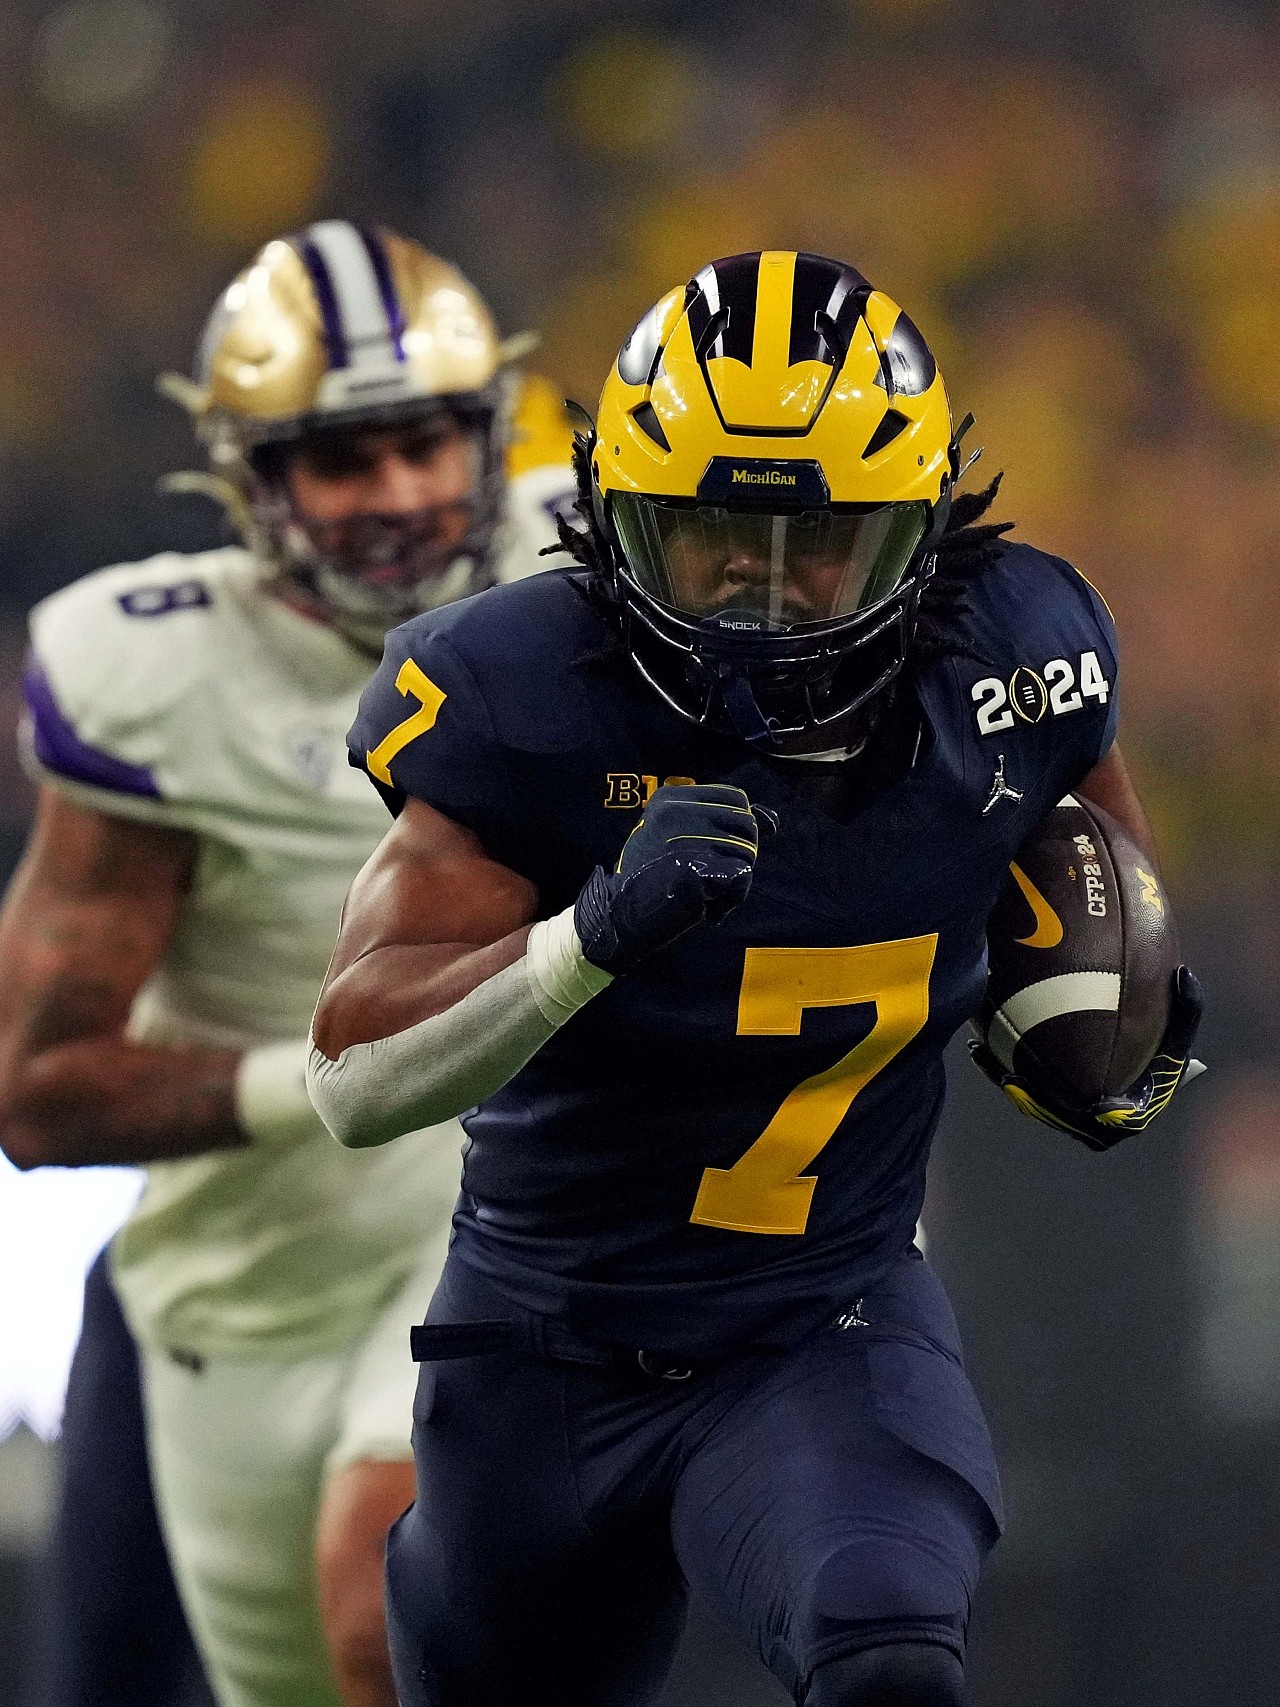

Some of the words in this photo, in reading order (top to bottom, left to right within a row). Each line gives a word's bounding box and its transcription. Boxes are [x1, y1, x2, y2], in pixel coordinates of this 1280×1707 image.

[117, 579, 213, 618] 8
[366, 657, 447, 788] 7
[689, 933, 939, 1234] 7
